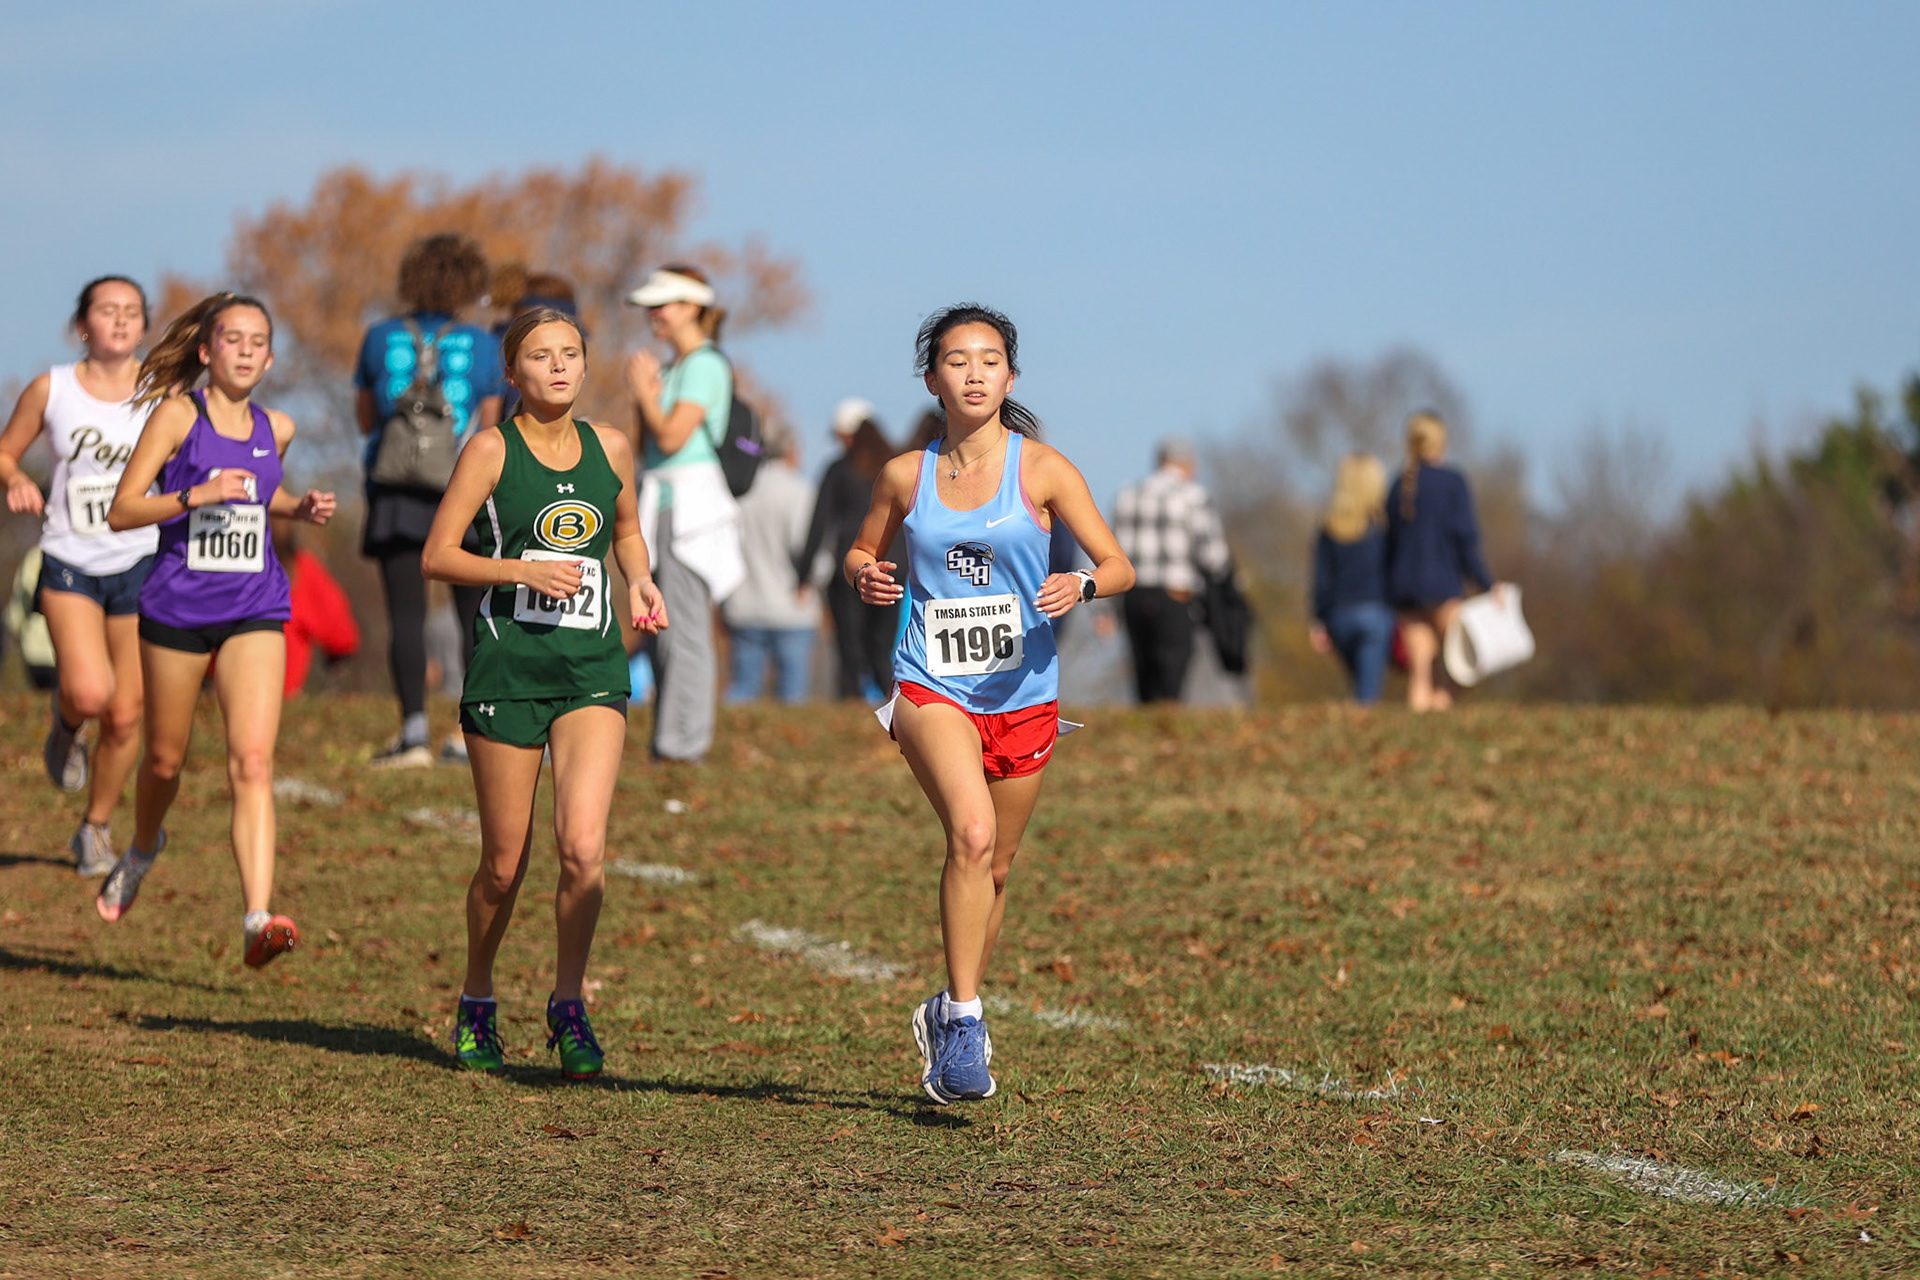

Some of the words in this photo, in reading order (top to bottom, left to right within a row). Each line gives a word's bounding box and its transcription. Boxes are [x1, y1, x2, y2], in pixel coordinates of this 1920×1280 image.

[67, 426, 132, 470] Pop
[84, 501, 112, 524] 11
[551, 510, 588, 541] B
[195, 531, 258, 558] 1060
[948, 550, 990, 585] SBA
[934, 607, 967, 620] TMSAA
[968, 605, 997, 618] STATE
[999, 603, 1011, 614] XC
[934, 623, 1014, 664] 1196
